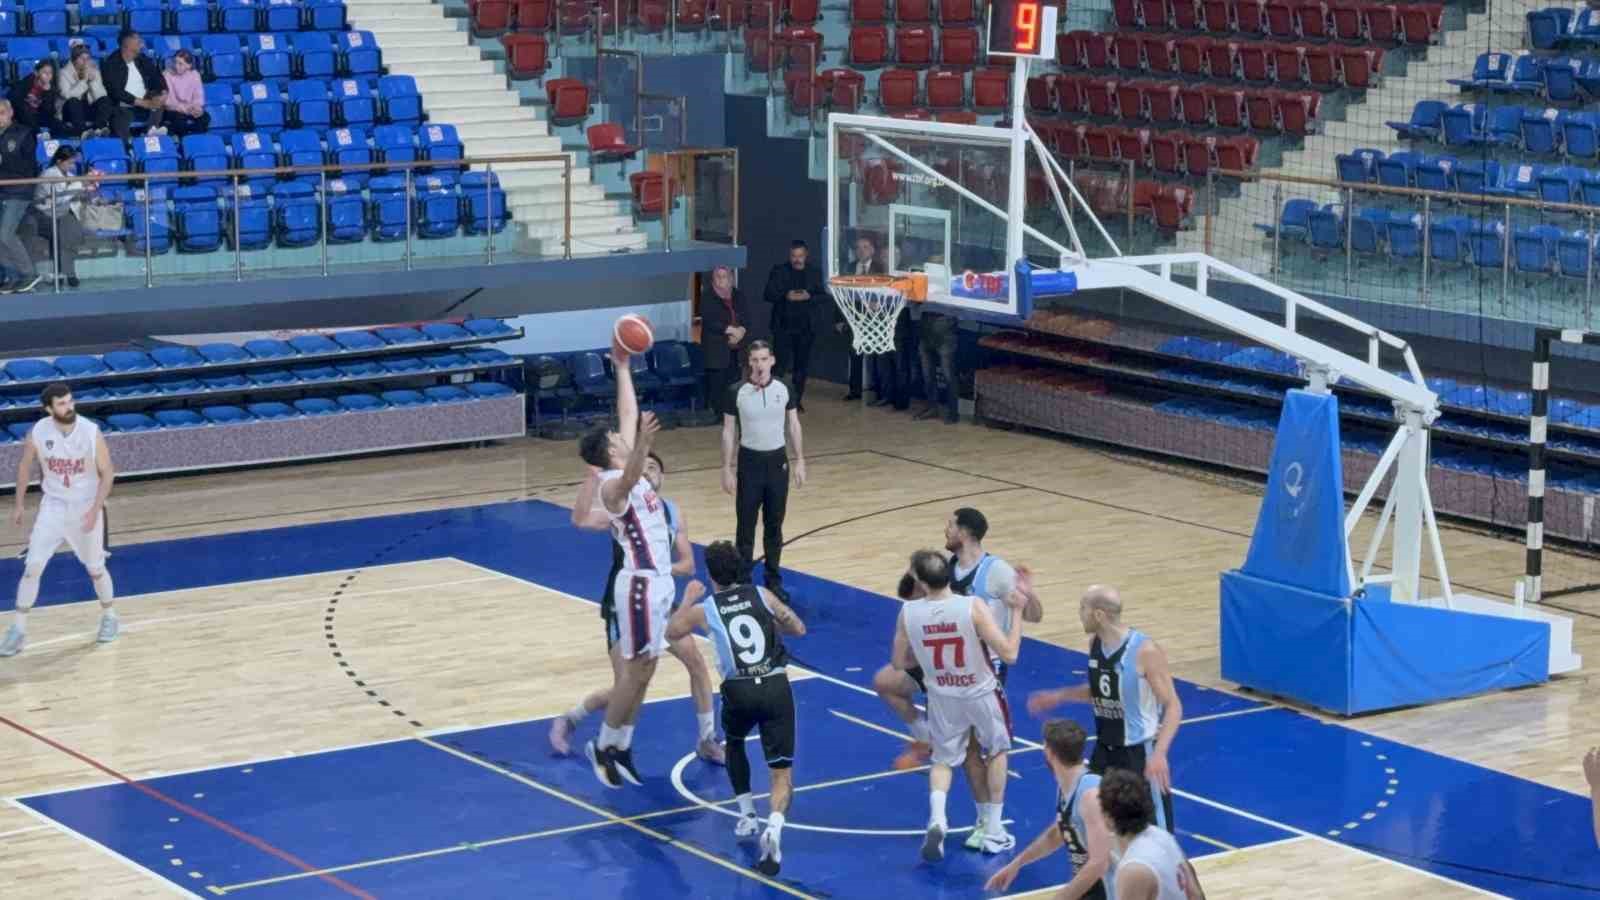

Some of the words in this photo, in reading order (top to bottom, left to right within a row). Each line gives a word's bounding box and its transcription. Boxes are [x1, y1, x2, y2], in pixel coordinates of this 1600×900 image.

[1016, 3, 1037, 49] 9
[729, 614, 766, 664] 9
[922, 636, 965, 670] 77
[936, 672, 976, 687] DÜZCE
[1099, 673, 1111, 698] 6
